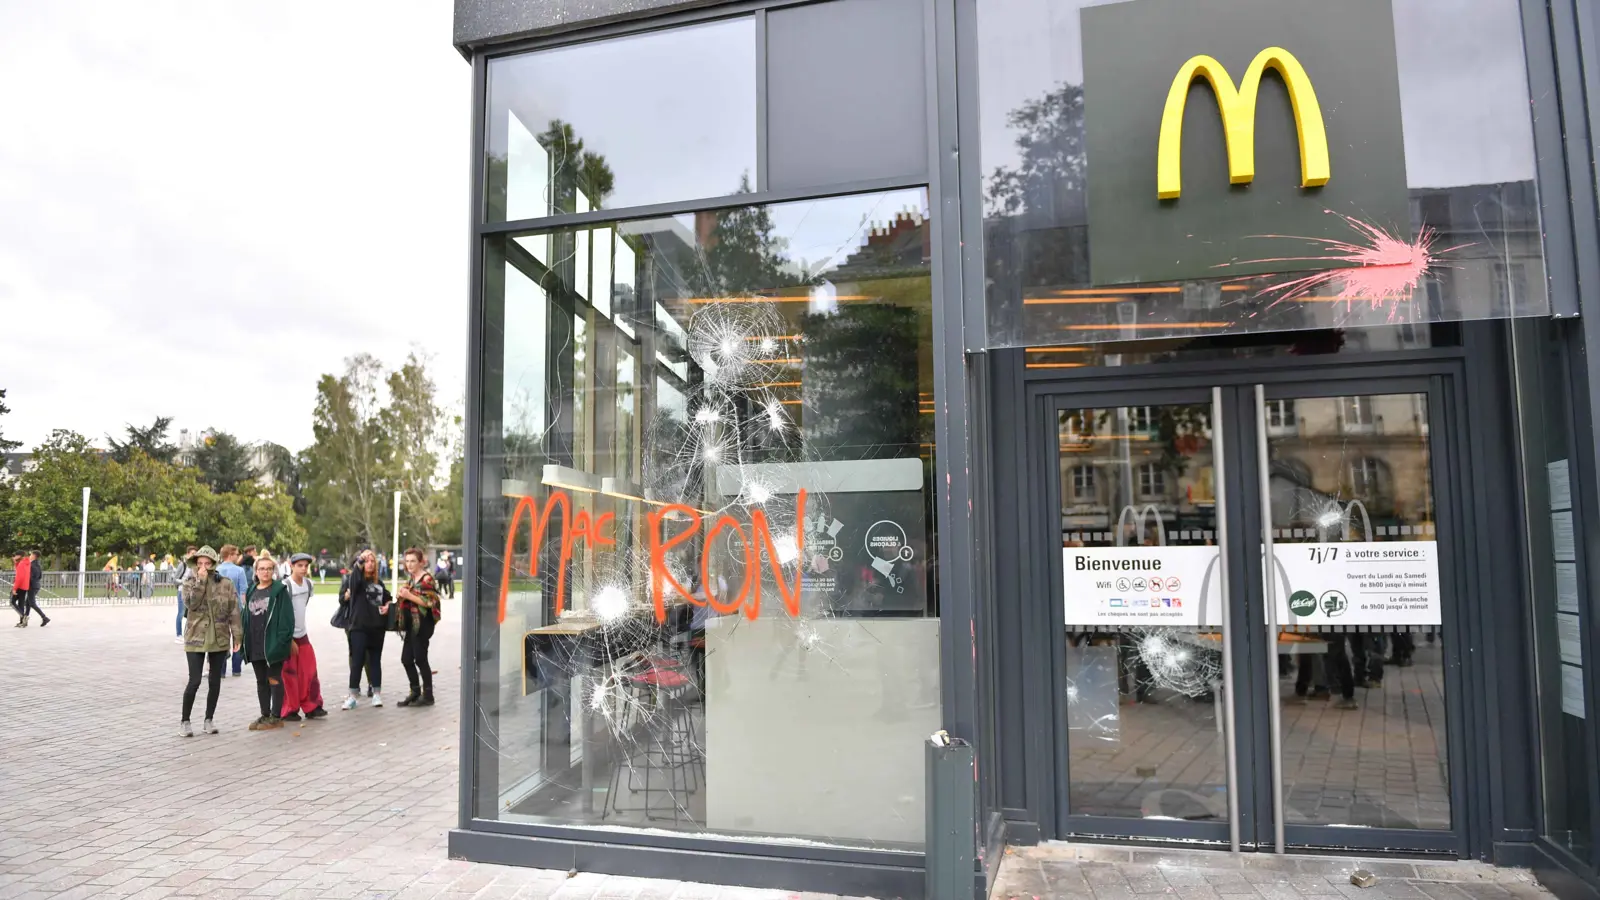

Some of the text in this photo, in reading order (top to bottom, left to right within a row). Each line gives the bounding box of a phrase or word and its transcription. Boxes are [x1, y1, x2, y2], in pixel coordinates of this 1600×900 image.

[1157, 46, 1330, 200] M
[648, 488, 807, 623] RON
[1075, 555, 1162, 571] Bienvenue
[1354, 550, 1380, 558] votre
[1382, 549, 1419, 558] service
